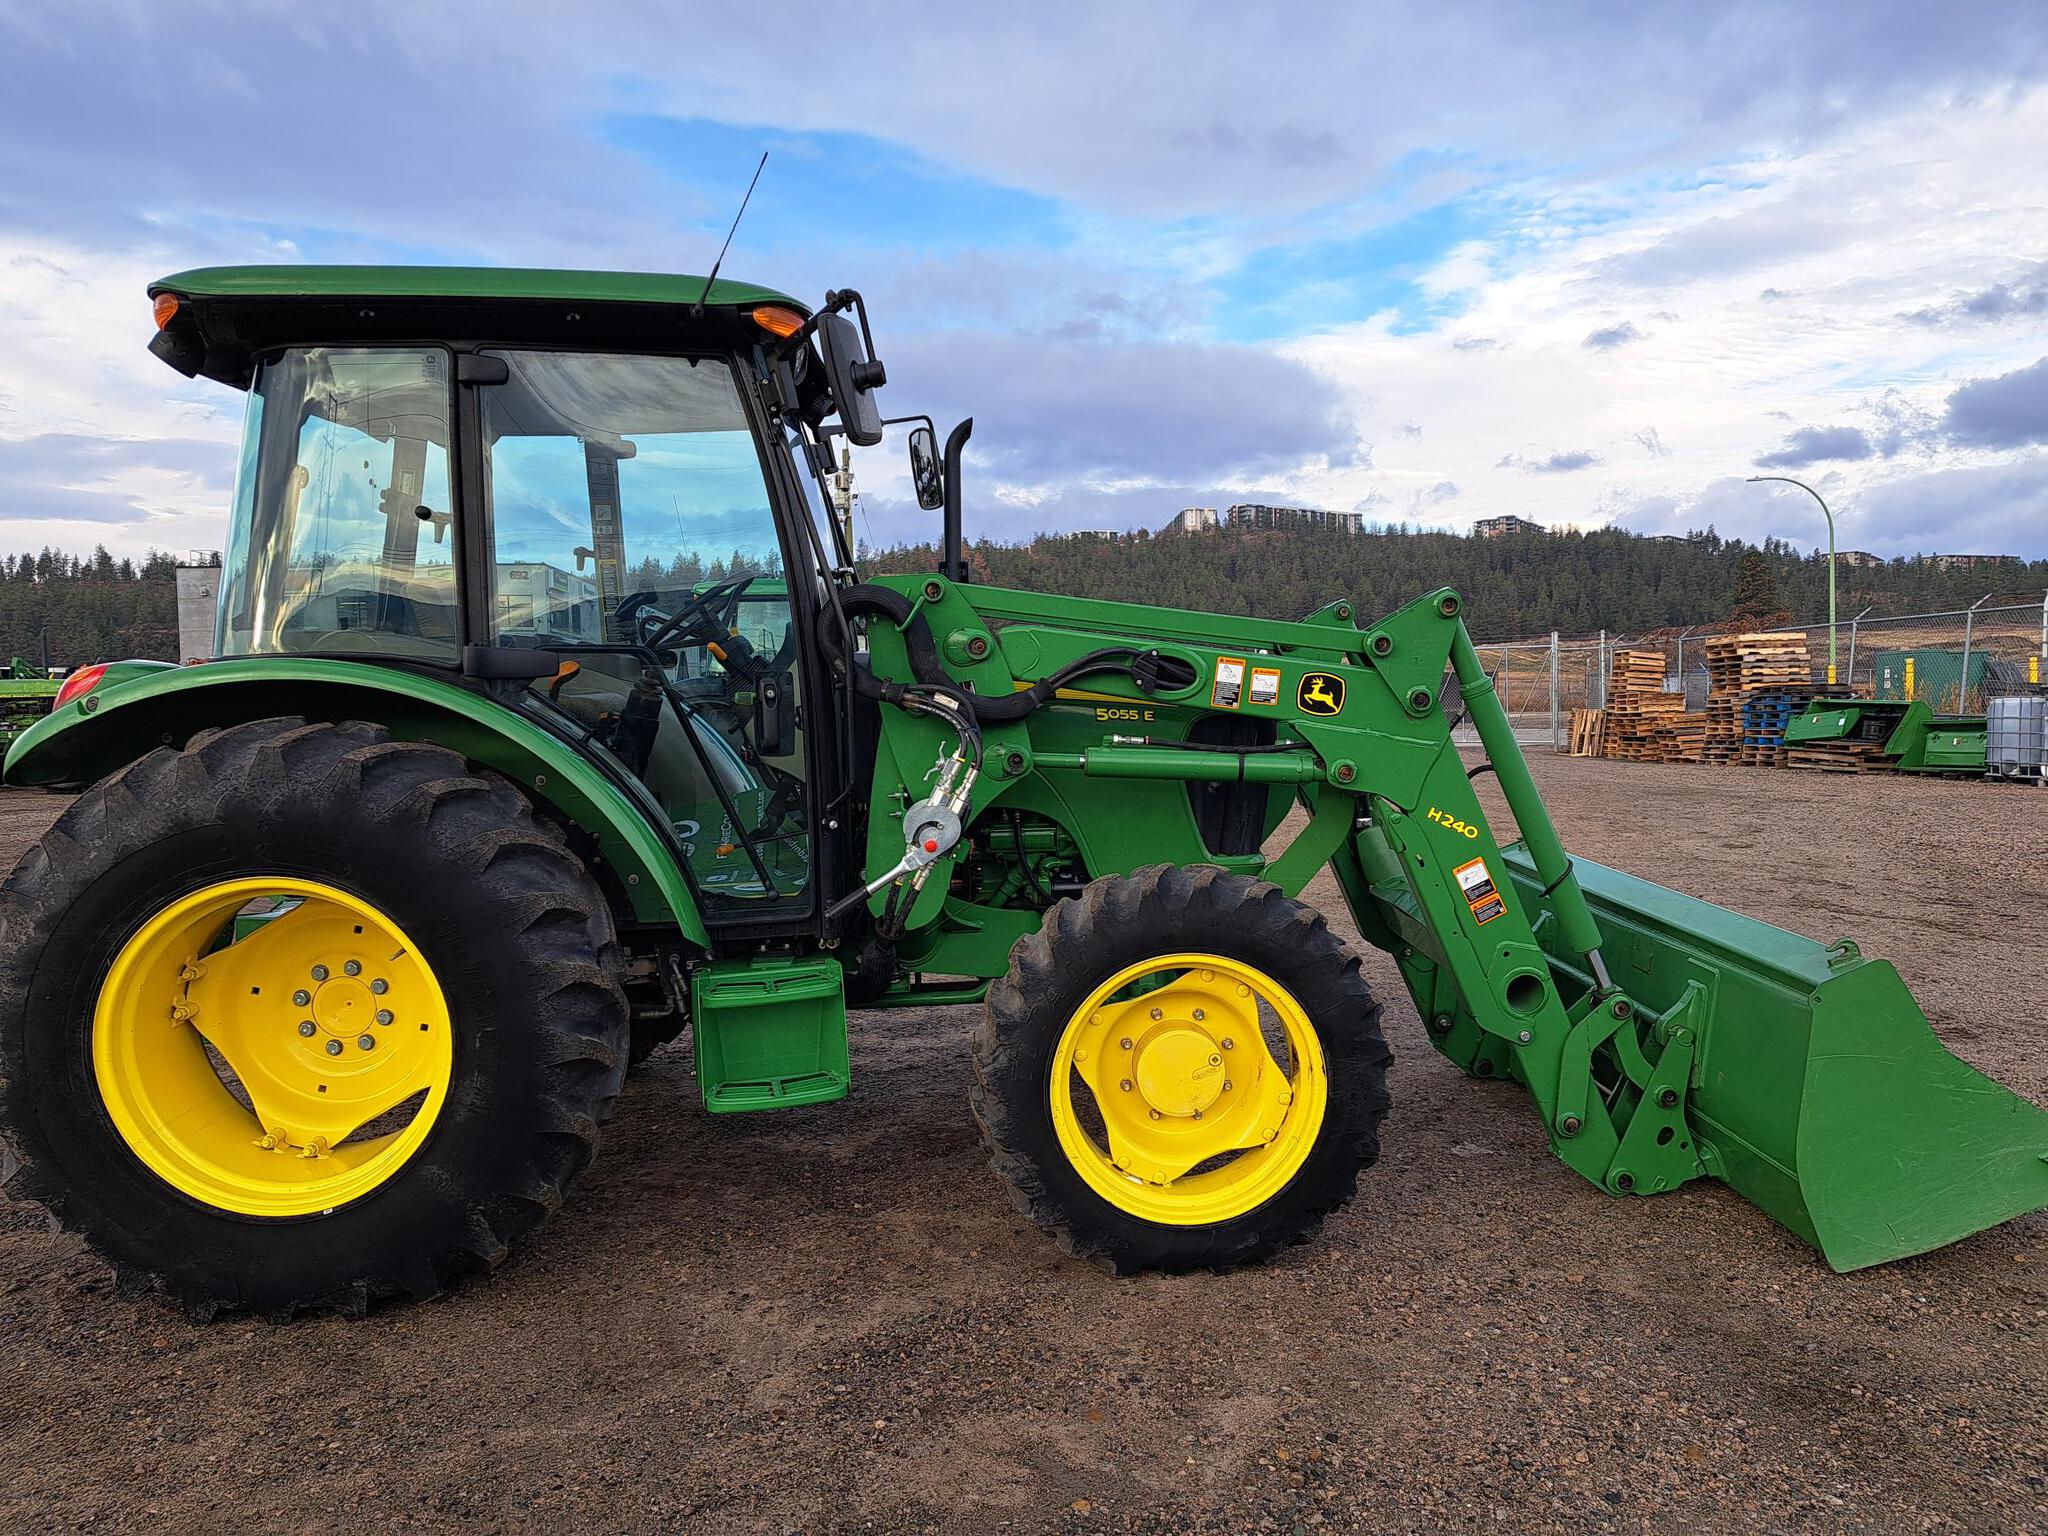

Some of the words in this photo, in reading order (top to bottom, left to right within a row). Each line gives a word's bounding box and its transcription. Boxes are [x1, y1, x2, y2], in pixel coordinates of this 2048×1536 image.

[1096, 708, 1139, 721] 5055
[1144, 710, 1155, 721] E
[1427, 807, 1479, 839] H240
